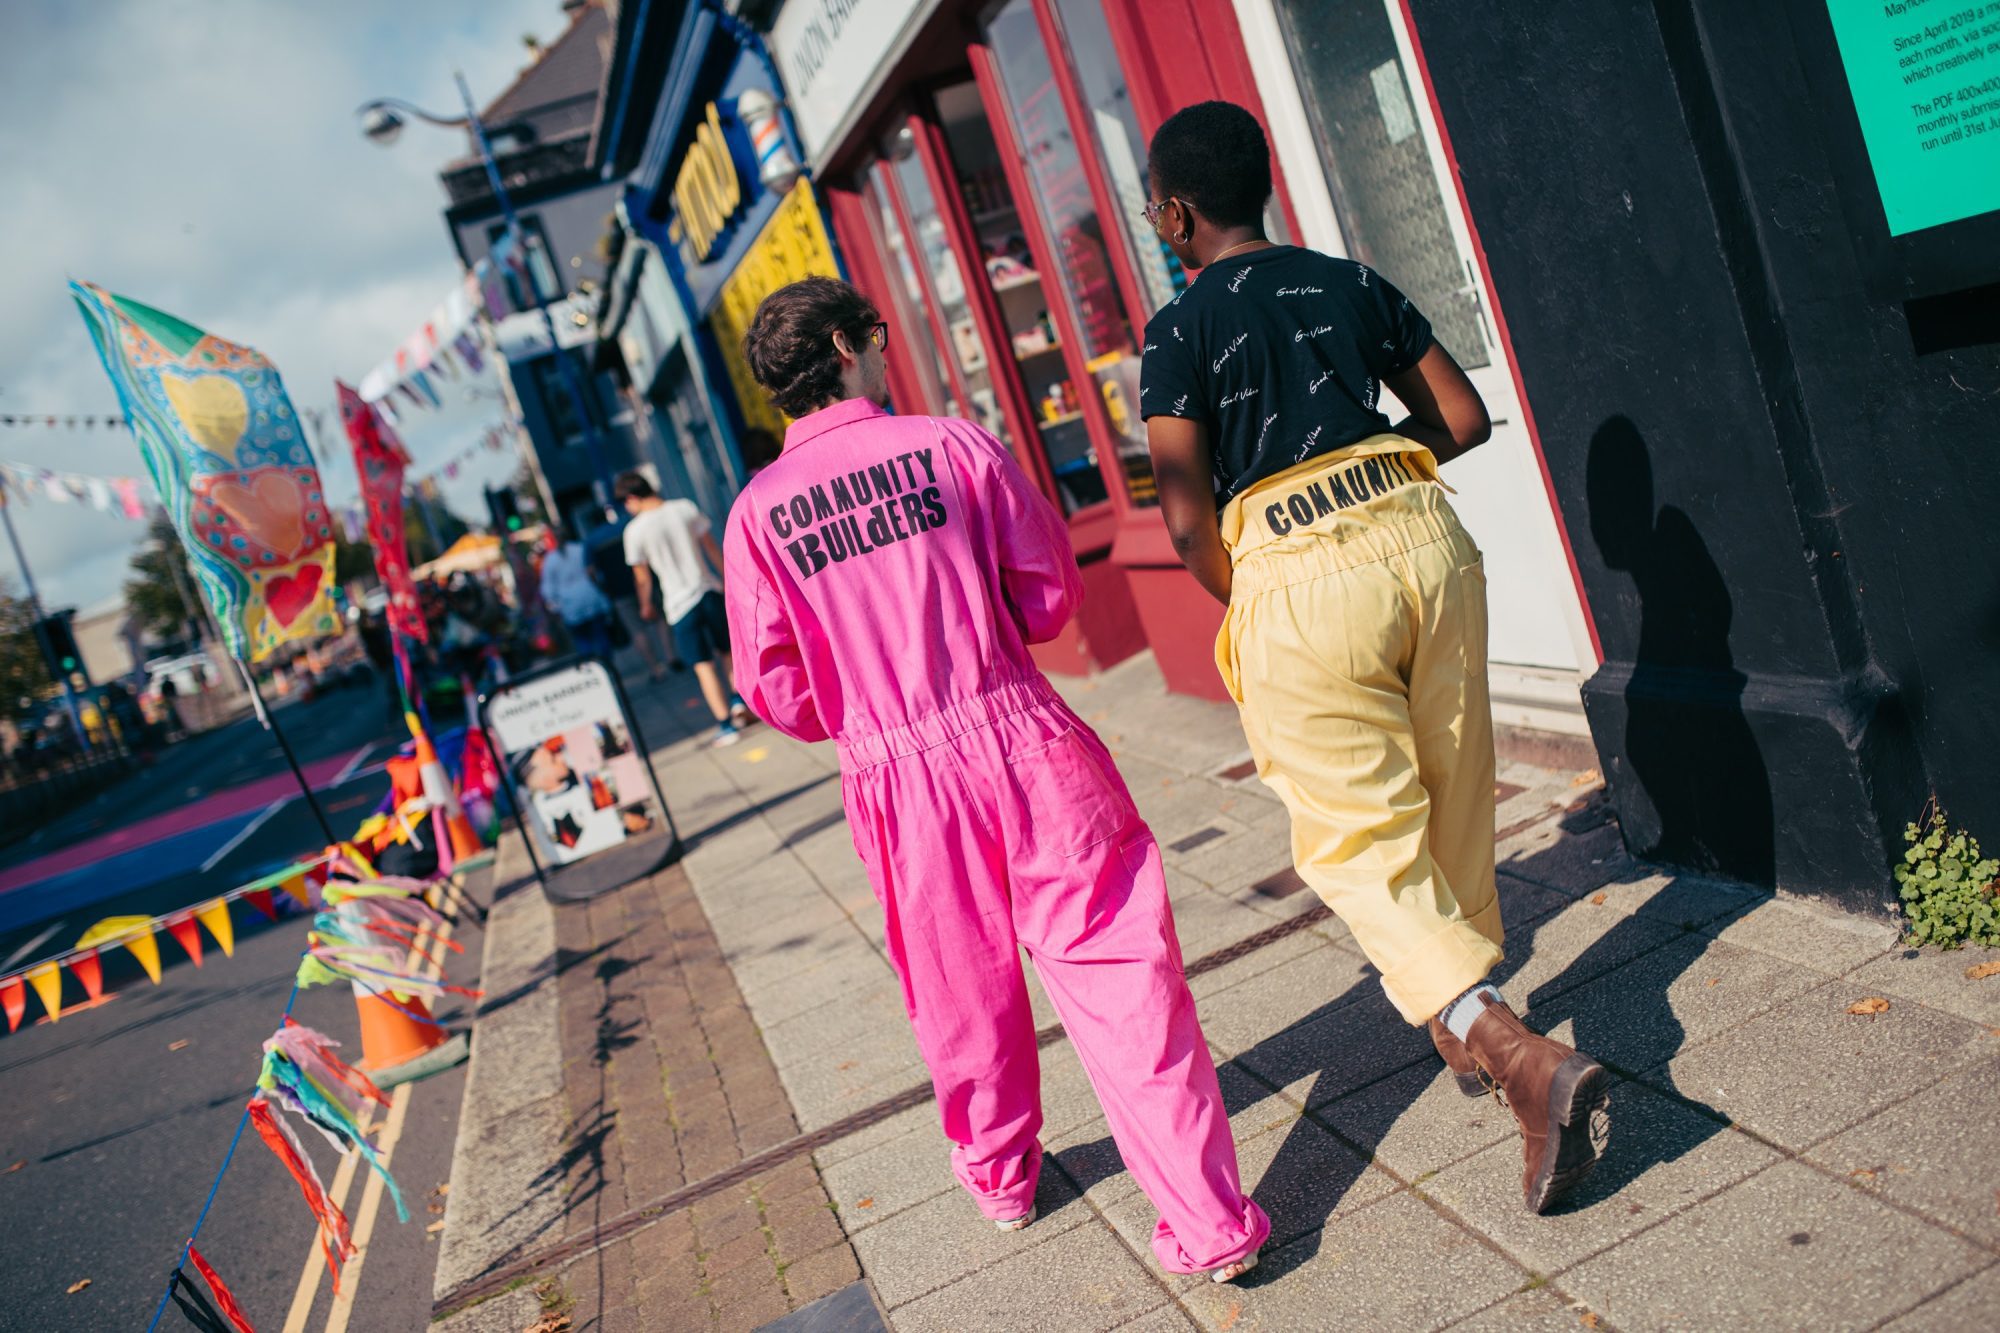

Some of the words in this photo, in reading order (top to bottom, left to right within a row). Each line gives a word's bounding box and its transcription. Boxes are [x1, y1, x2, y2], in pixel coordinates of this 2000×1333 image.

[1894, 33, 1922, 52] Since
[1924, 20, 1949, 40] April
[1950, 9, 1975, 29] 2019
[1977, 8, 1985, 19] a
[1899, 50, 1923, 68] each
[1924, 36, 1962, 59] month,
[1962, 29, 1980, 43] via
[1903, 64, 1935, 85] which
[1935, 46, 1985, 73] creatively
[1911, 104, 1933, 118] The
[1933, 92, 1954, 111] PDF
[1917, 113, 1959, 135] monthly
[1921, 138, 1940, 152] run
[1940, 127, 1964, 145] until
[1964, 121, 1987, 138] 31st
[1276, 287, 1299, 297] Good
[1300, 286, 1324, 296] Vibes
[1212, 349, 1230, 374] Good
[1229, 332, 1248, 352] Vibes
[1309, 371, 1328, 395] Good
[1220, 392, 1238, 408] Good
[1240, 387, 1259, 400] Vibes
[1306, 425, 1322, 446] Vibes
[769, 448, 937, 540] COMMUNITY
